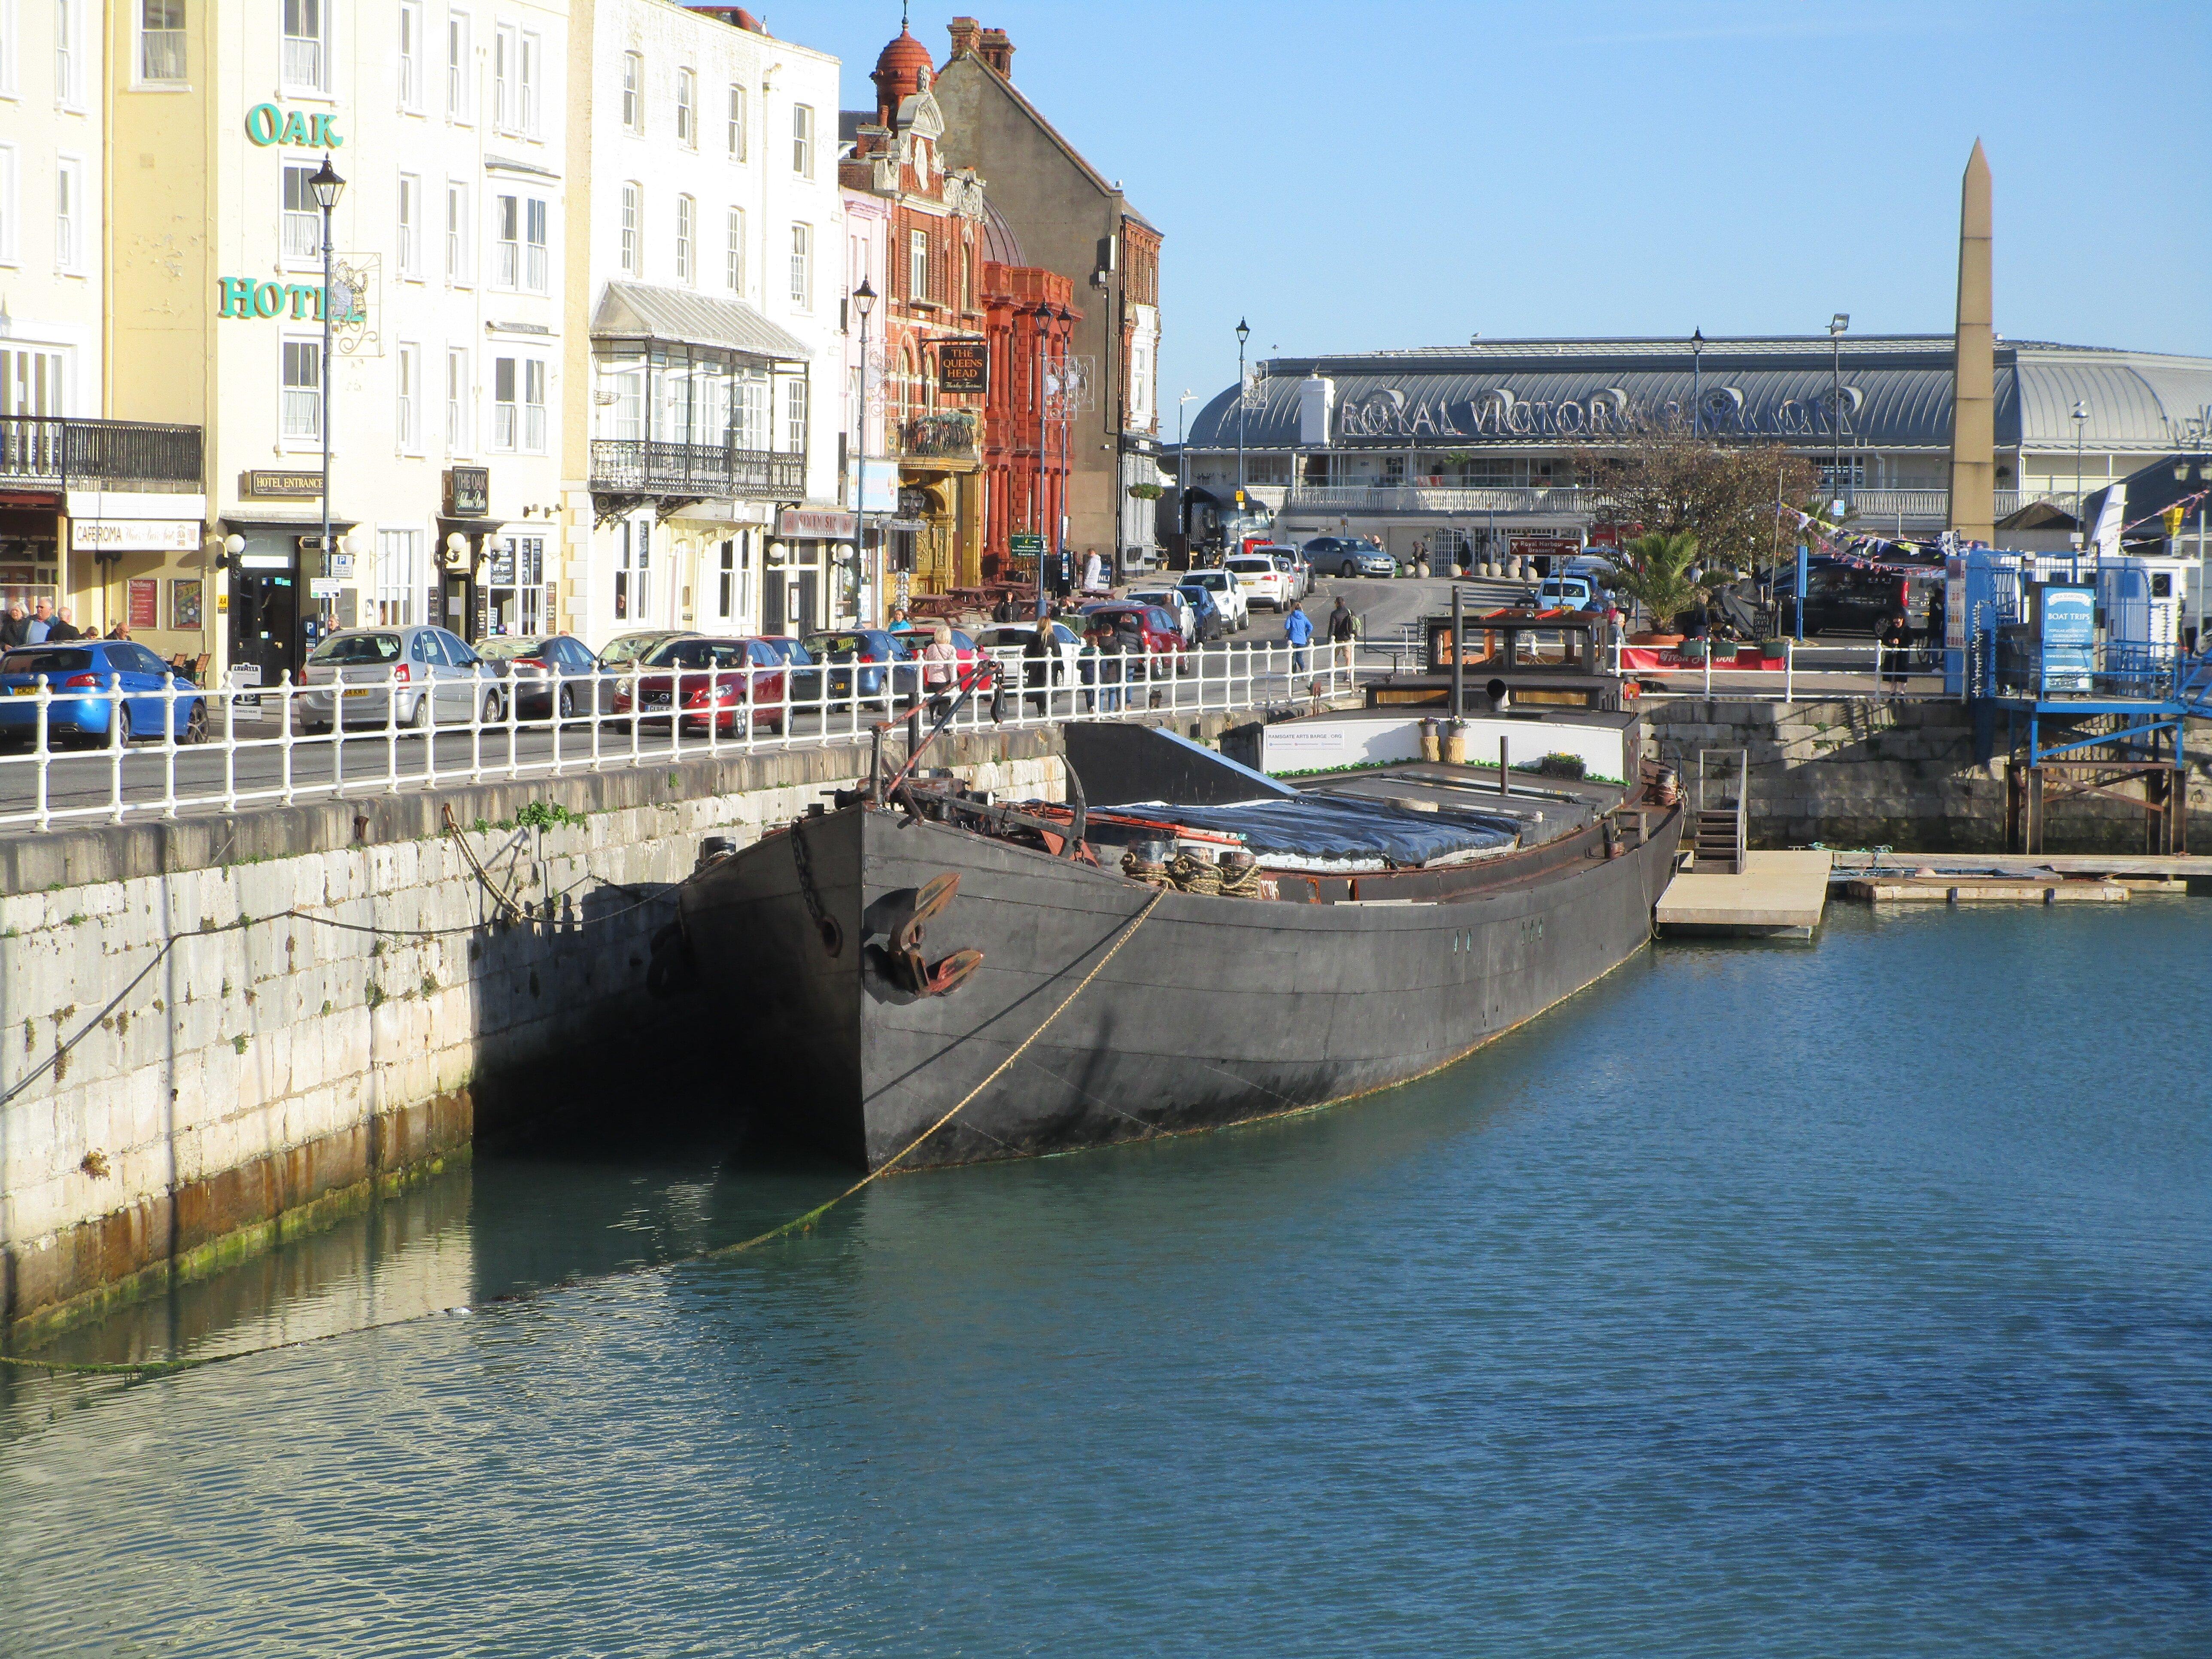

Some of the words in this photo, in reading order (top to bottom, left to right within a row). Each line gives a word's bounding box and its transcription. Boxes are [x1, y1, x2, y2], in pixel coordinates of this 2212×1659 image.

[246, 103, 343, 148] OAK
[951, 349, 973, 357] THE
[943, 359, 983, 368] QUEENS
[947, 369, 977, 377] HEAD
[1341, 400, 1459, 435] ROYAL
[257, 477, 282, 488] HOTEL
[284, 478, 323, 488] ENTRANCE
[456, 473, 471, 489] THE
[471, 474, 486, 489] OAK
[799, 515, 821, 528] SIXTY
[825, 515, 837, 529] SIX
[77, 526, 97, 543] CAFE
[98, 526, 122, 544] ROMA
[339, 556, 346, 565] P
[307, 622, 314, 633] P
